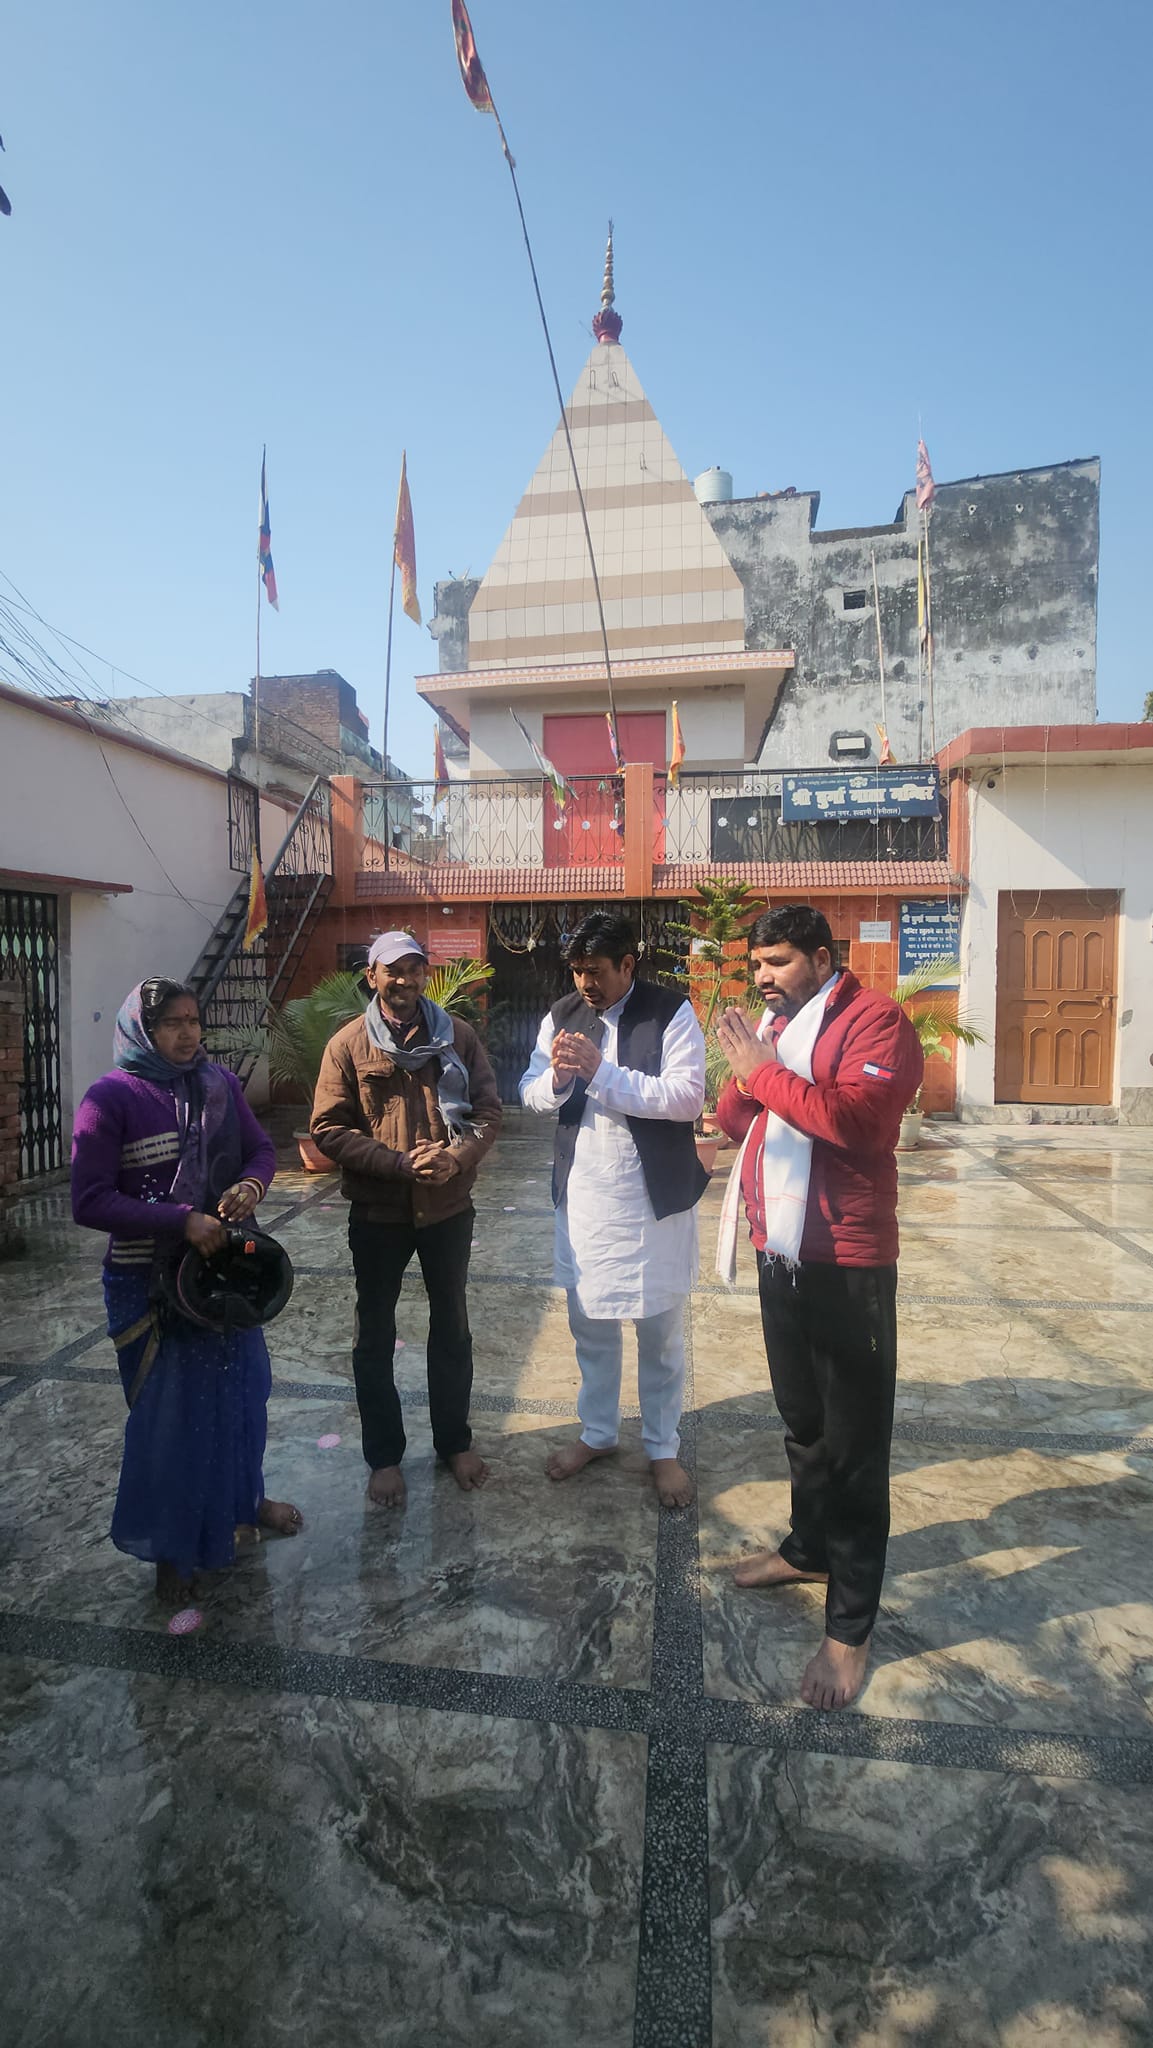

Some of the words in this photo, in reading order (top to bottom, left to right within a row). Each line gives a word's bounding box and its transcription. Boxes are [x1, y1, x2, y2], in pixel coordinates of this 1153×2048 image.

[791, 788, 812, 806] श्री
[815, 786, 846, 809] दुर्गा
[849, 788, 886, 803] माता
[889, 783, 935, 801] मन्दिर
